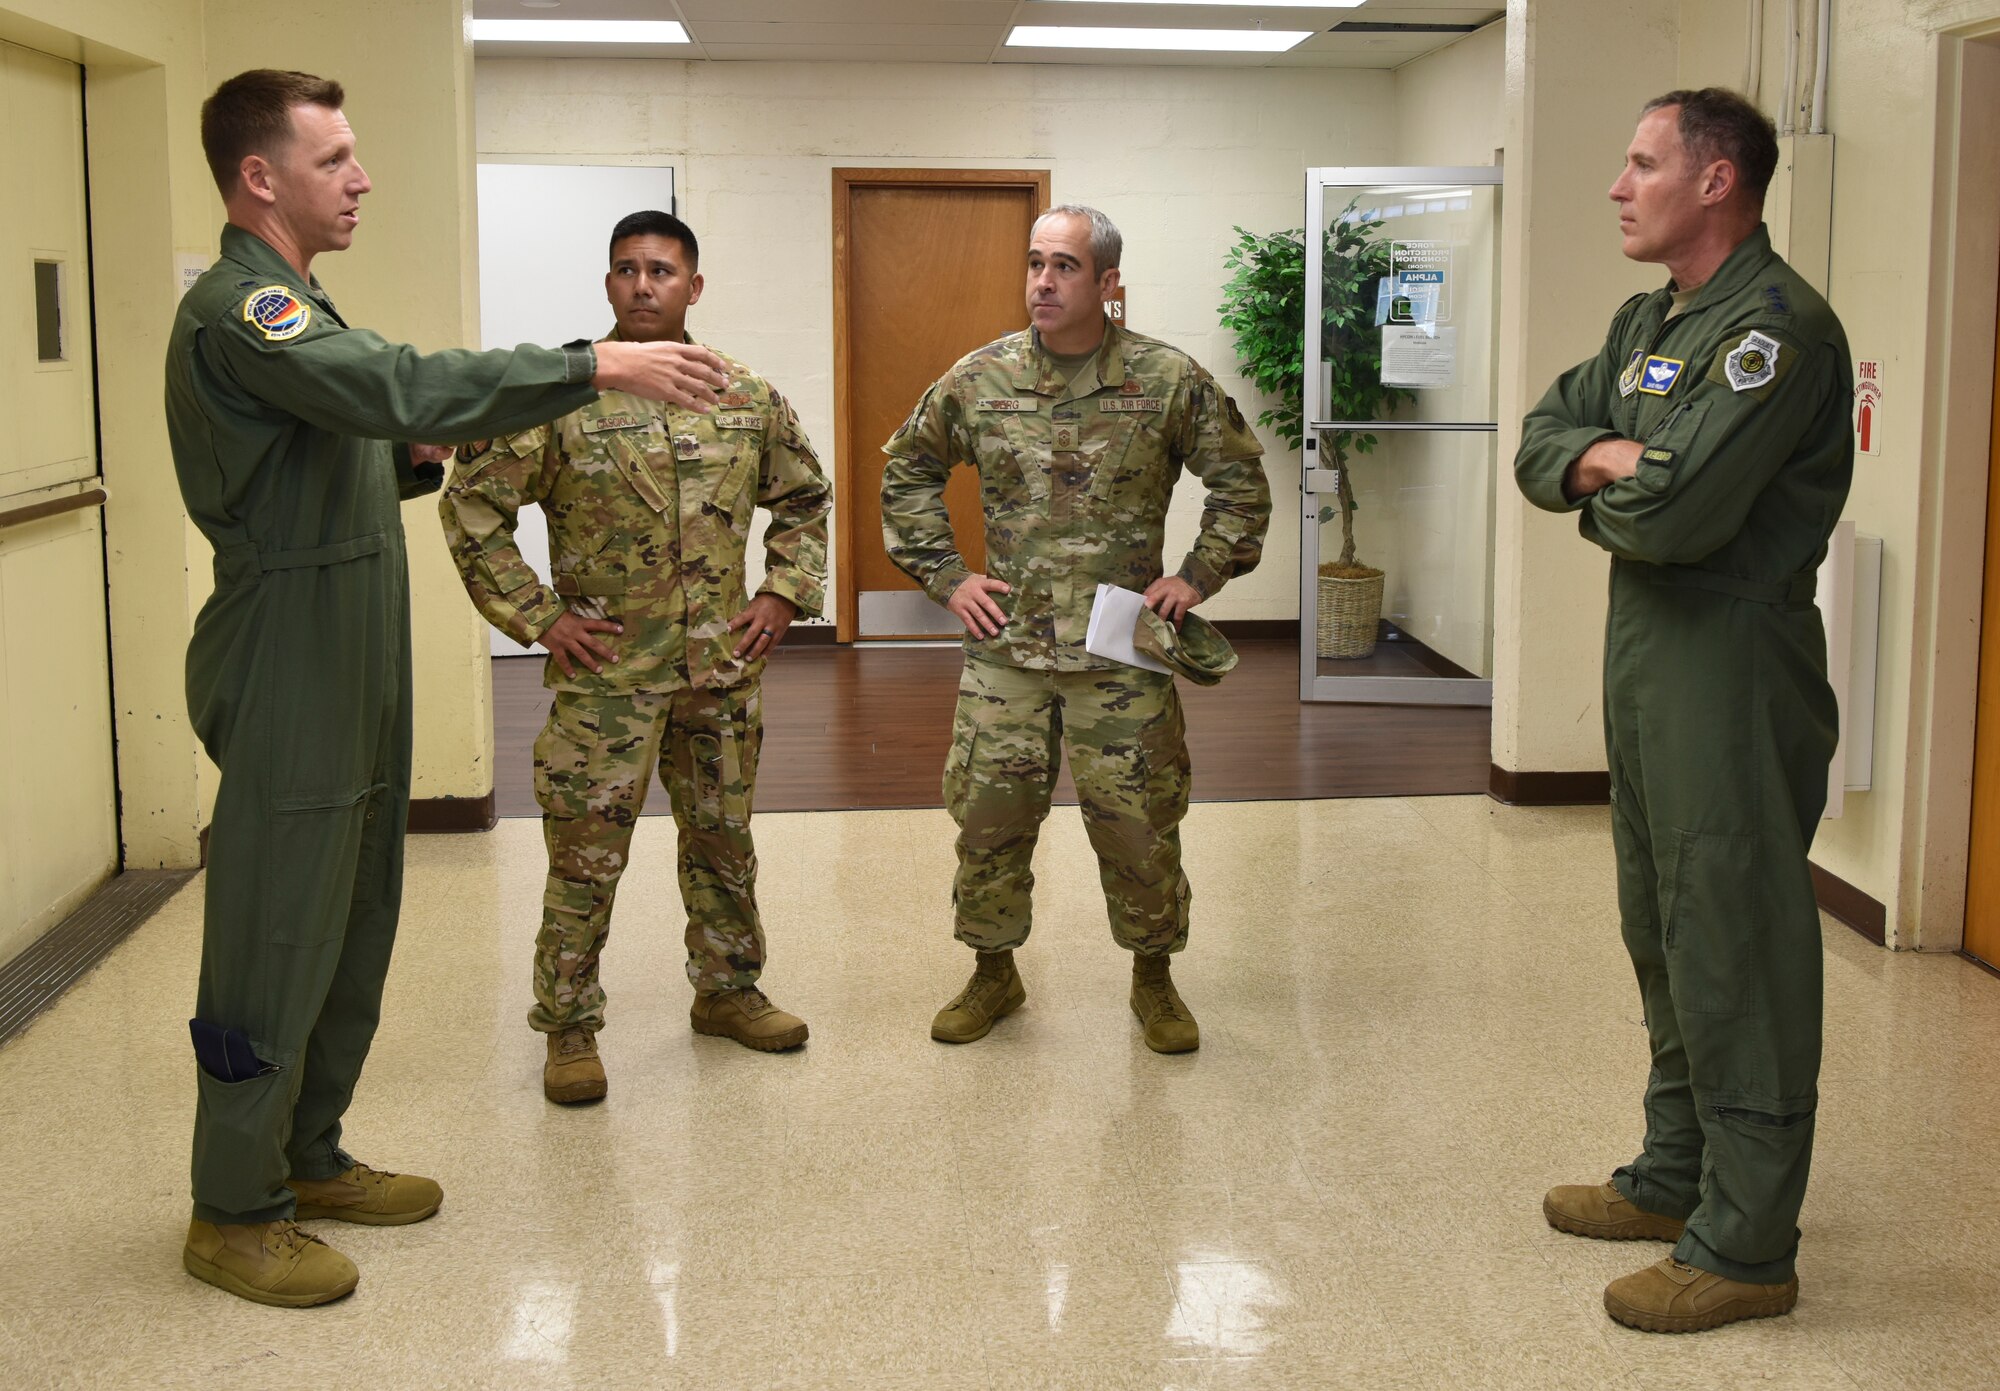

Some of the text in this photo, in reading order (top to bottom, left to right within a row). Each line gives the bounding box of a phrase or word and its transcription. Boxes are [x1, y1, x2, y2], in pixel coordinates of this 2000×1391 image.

[1859, 362, 1877, 379] FIRE
[993, 400, 1019, 410] BERG
[1102, 399, 1160, 410] U.S. AIR FORCE
[732, 416, 743, 426] AIR
[745, 416, 761, 427] FORCE
